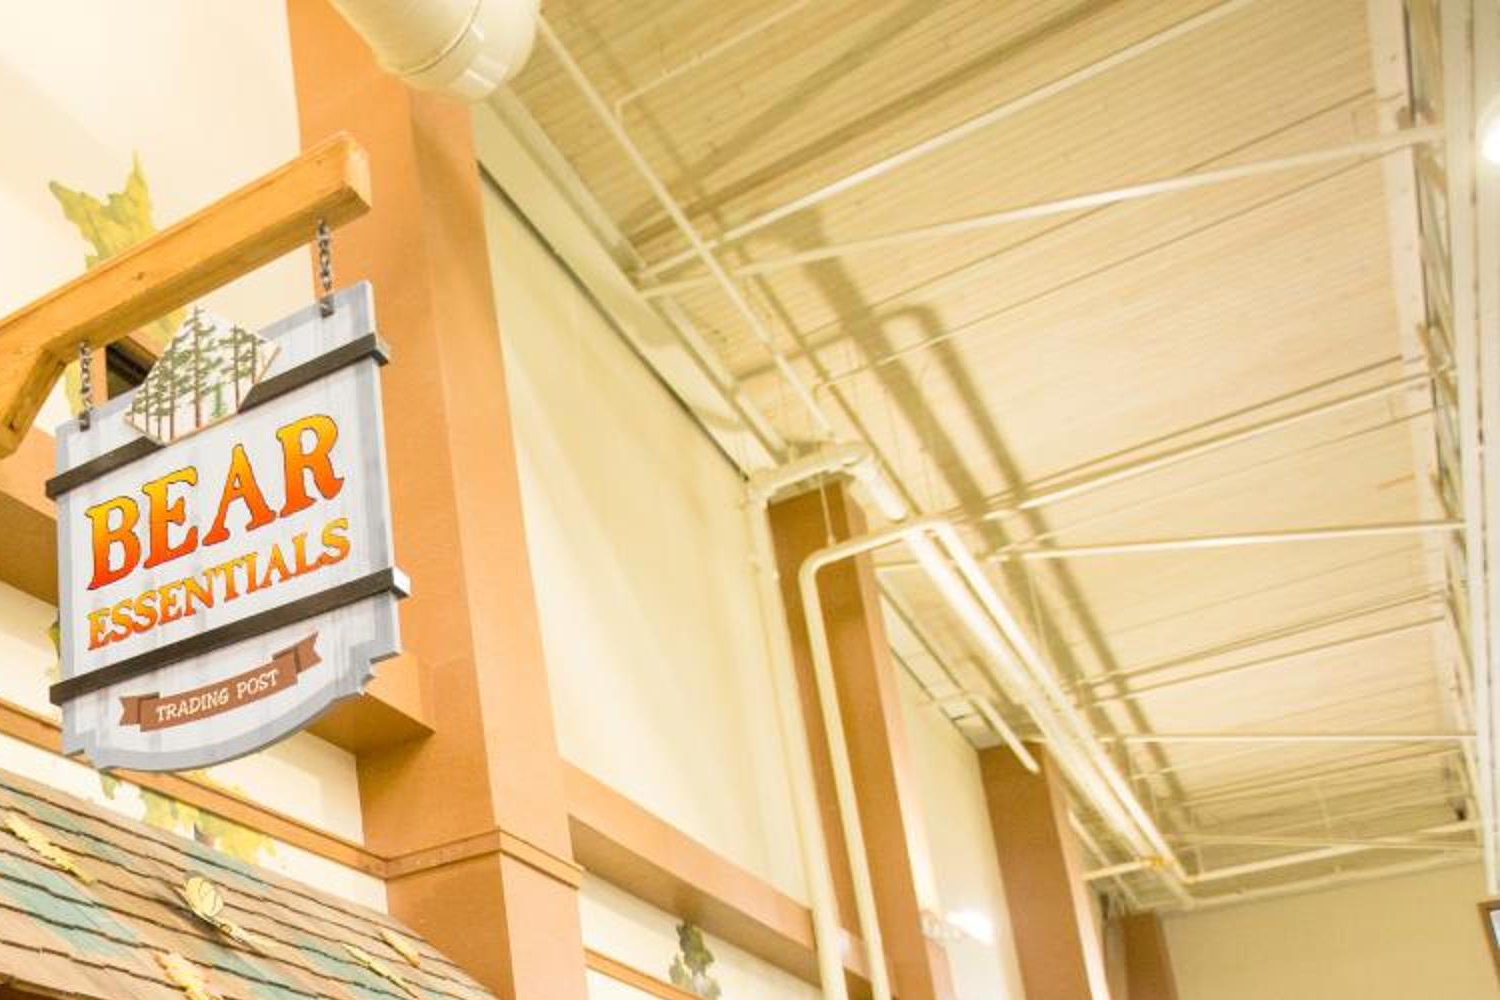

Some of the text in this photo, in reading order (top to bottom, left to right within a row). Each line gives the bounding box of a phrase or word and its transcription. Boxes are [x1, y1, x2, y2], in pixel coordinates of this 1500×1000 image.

[85, 414, 345, 590] BEAR
[87, 517, 351, 650] ESSENTIALS
[156, 669, 278, 720] TRADING POST
